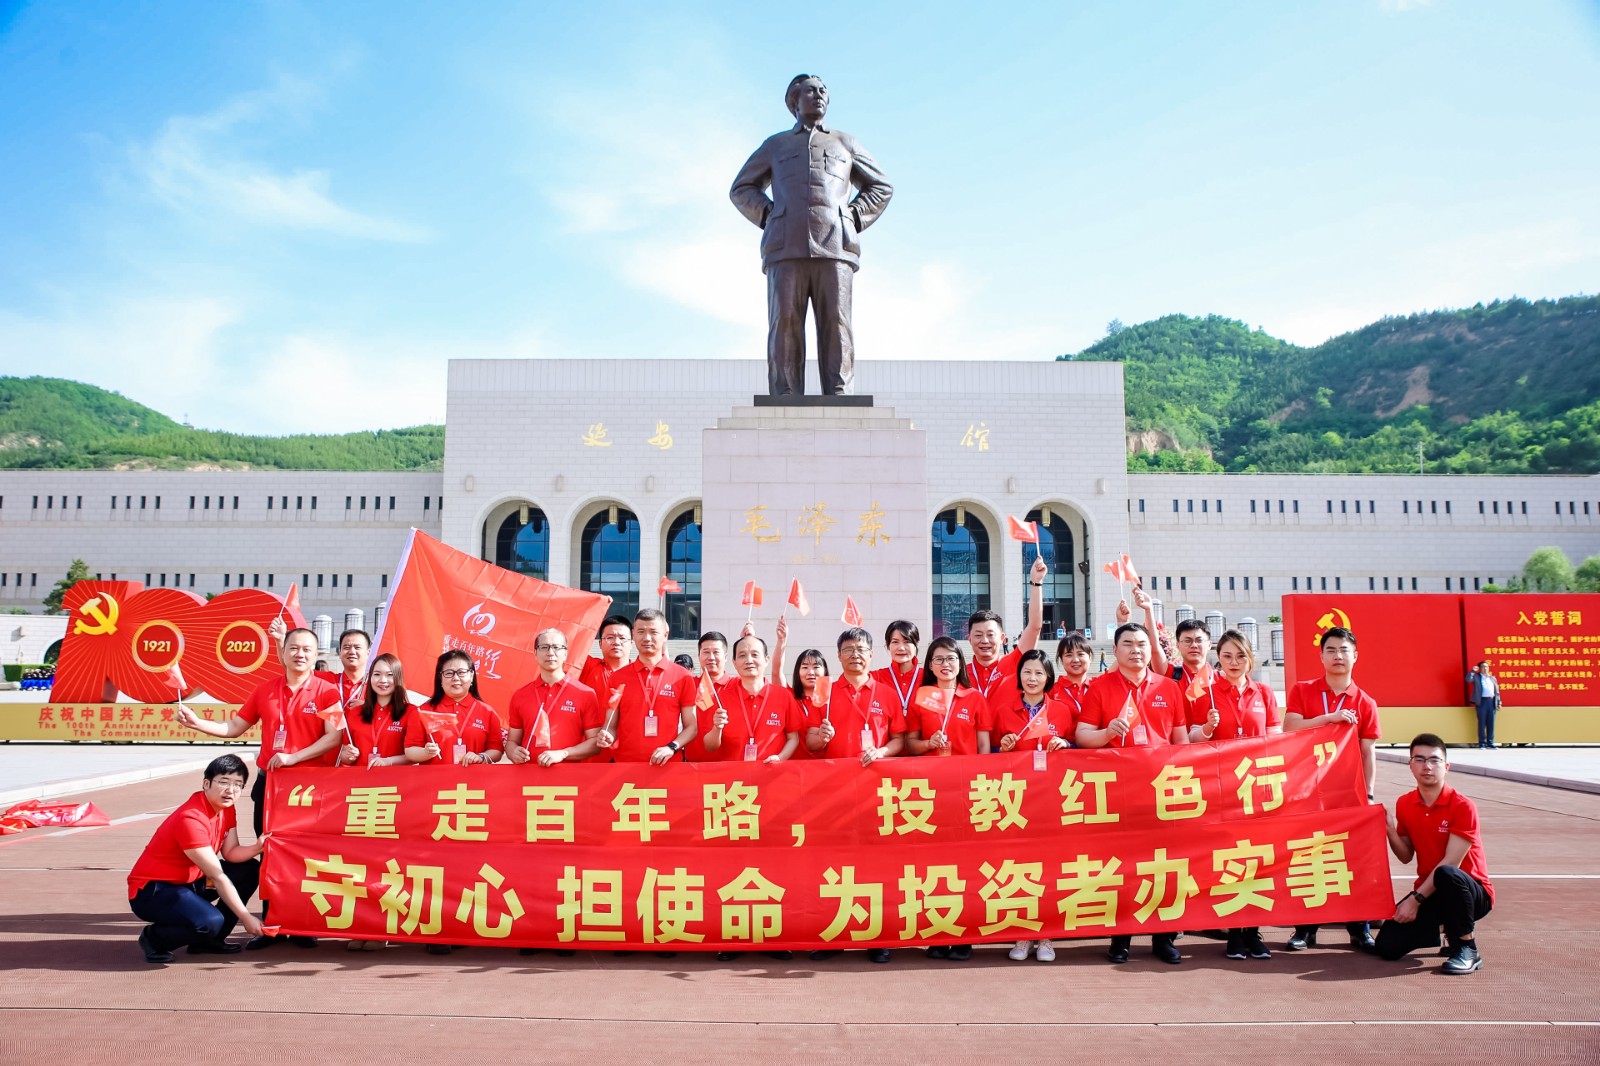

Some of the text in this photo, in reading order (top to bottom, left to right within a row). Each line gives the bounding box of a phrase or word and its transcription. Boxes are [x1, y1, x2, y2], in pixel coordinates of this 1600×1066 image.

[739, 501, 890, 547] 毛泽东
[1516, 611, 1582, 626] 入党誓词
[143, 640, 171, 652] 1921
[226, 641, 256, 652] 2021
[104, 722, 169, 730] Anniversary
[169, 730, 197, 738] Party
[301, 831, 1354, 945] 守初心 担使命 为投资者办实事
